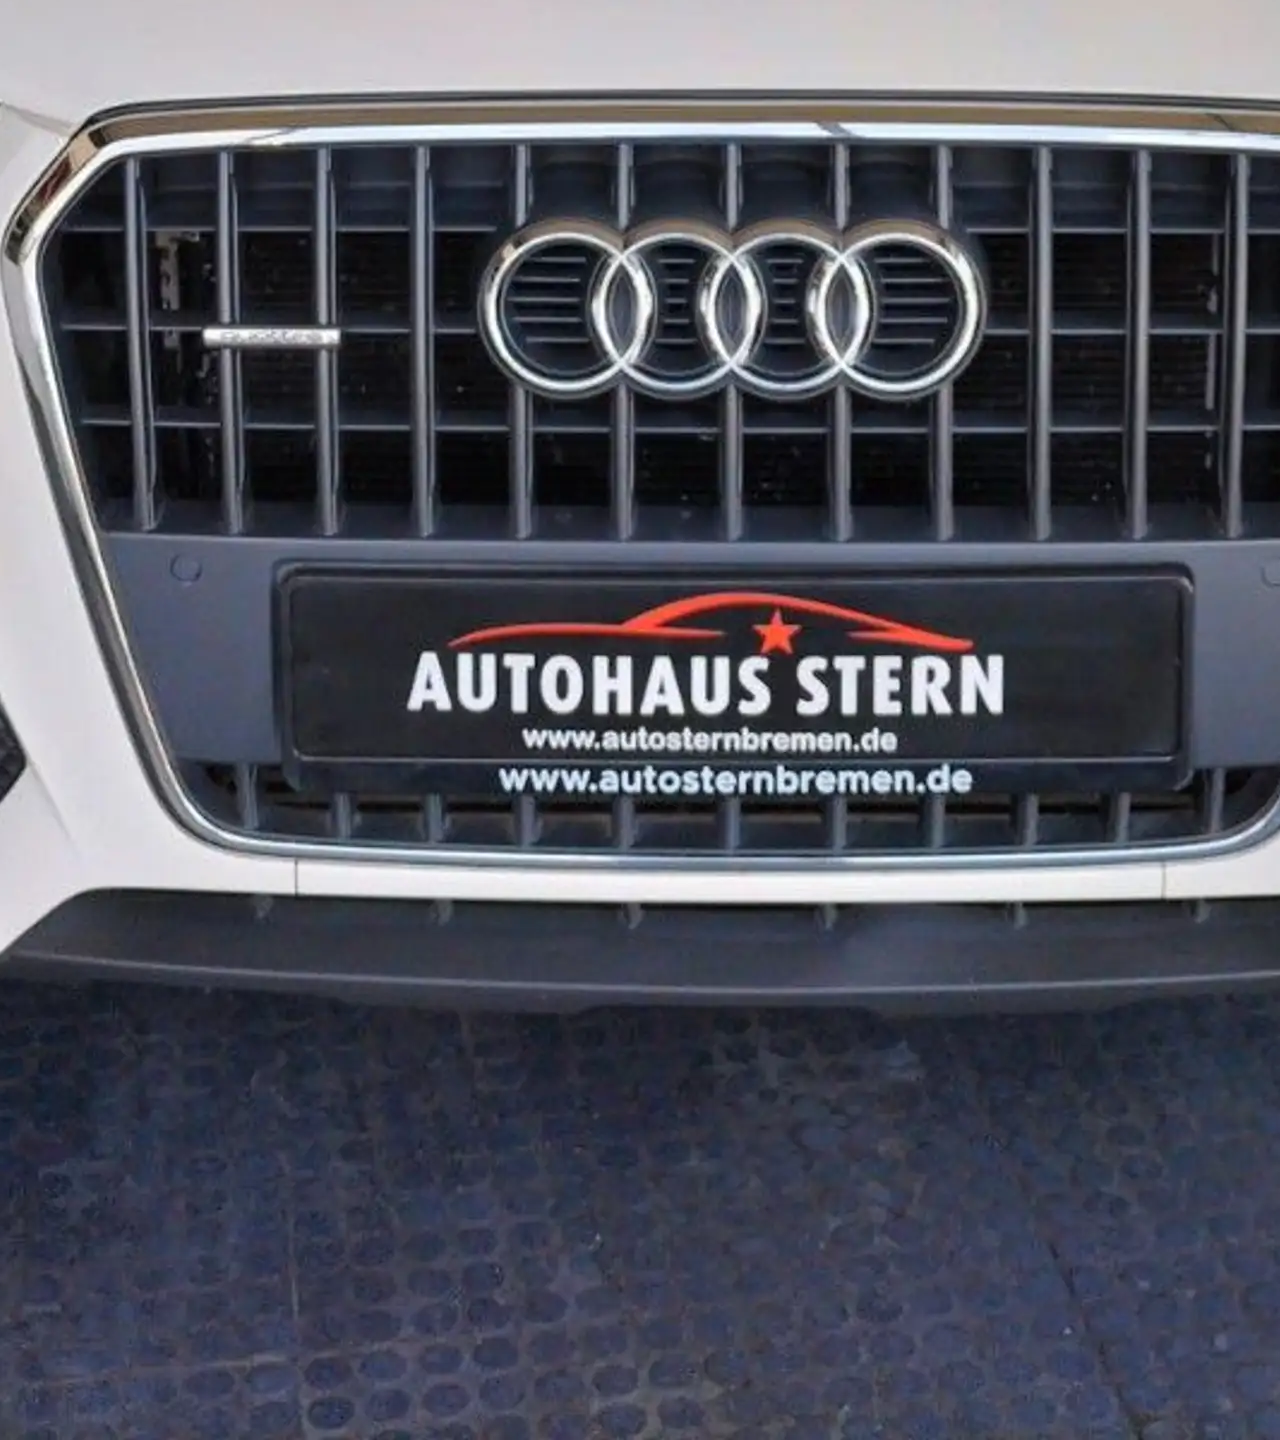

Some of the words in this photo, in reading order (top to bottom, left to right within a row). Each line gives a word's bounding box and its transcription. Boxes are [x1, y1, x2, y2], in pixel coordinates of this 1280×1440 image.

[406, 650, 772, 717] AUTOHAUS
[795, 654, 1005, 717] STERN
[521, 725, 899, 753] www.autosternbremen.de
[498, 762, 973, 796] www.autosternbremen.de
